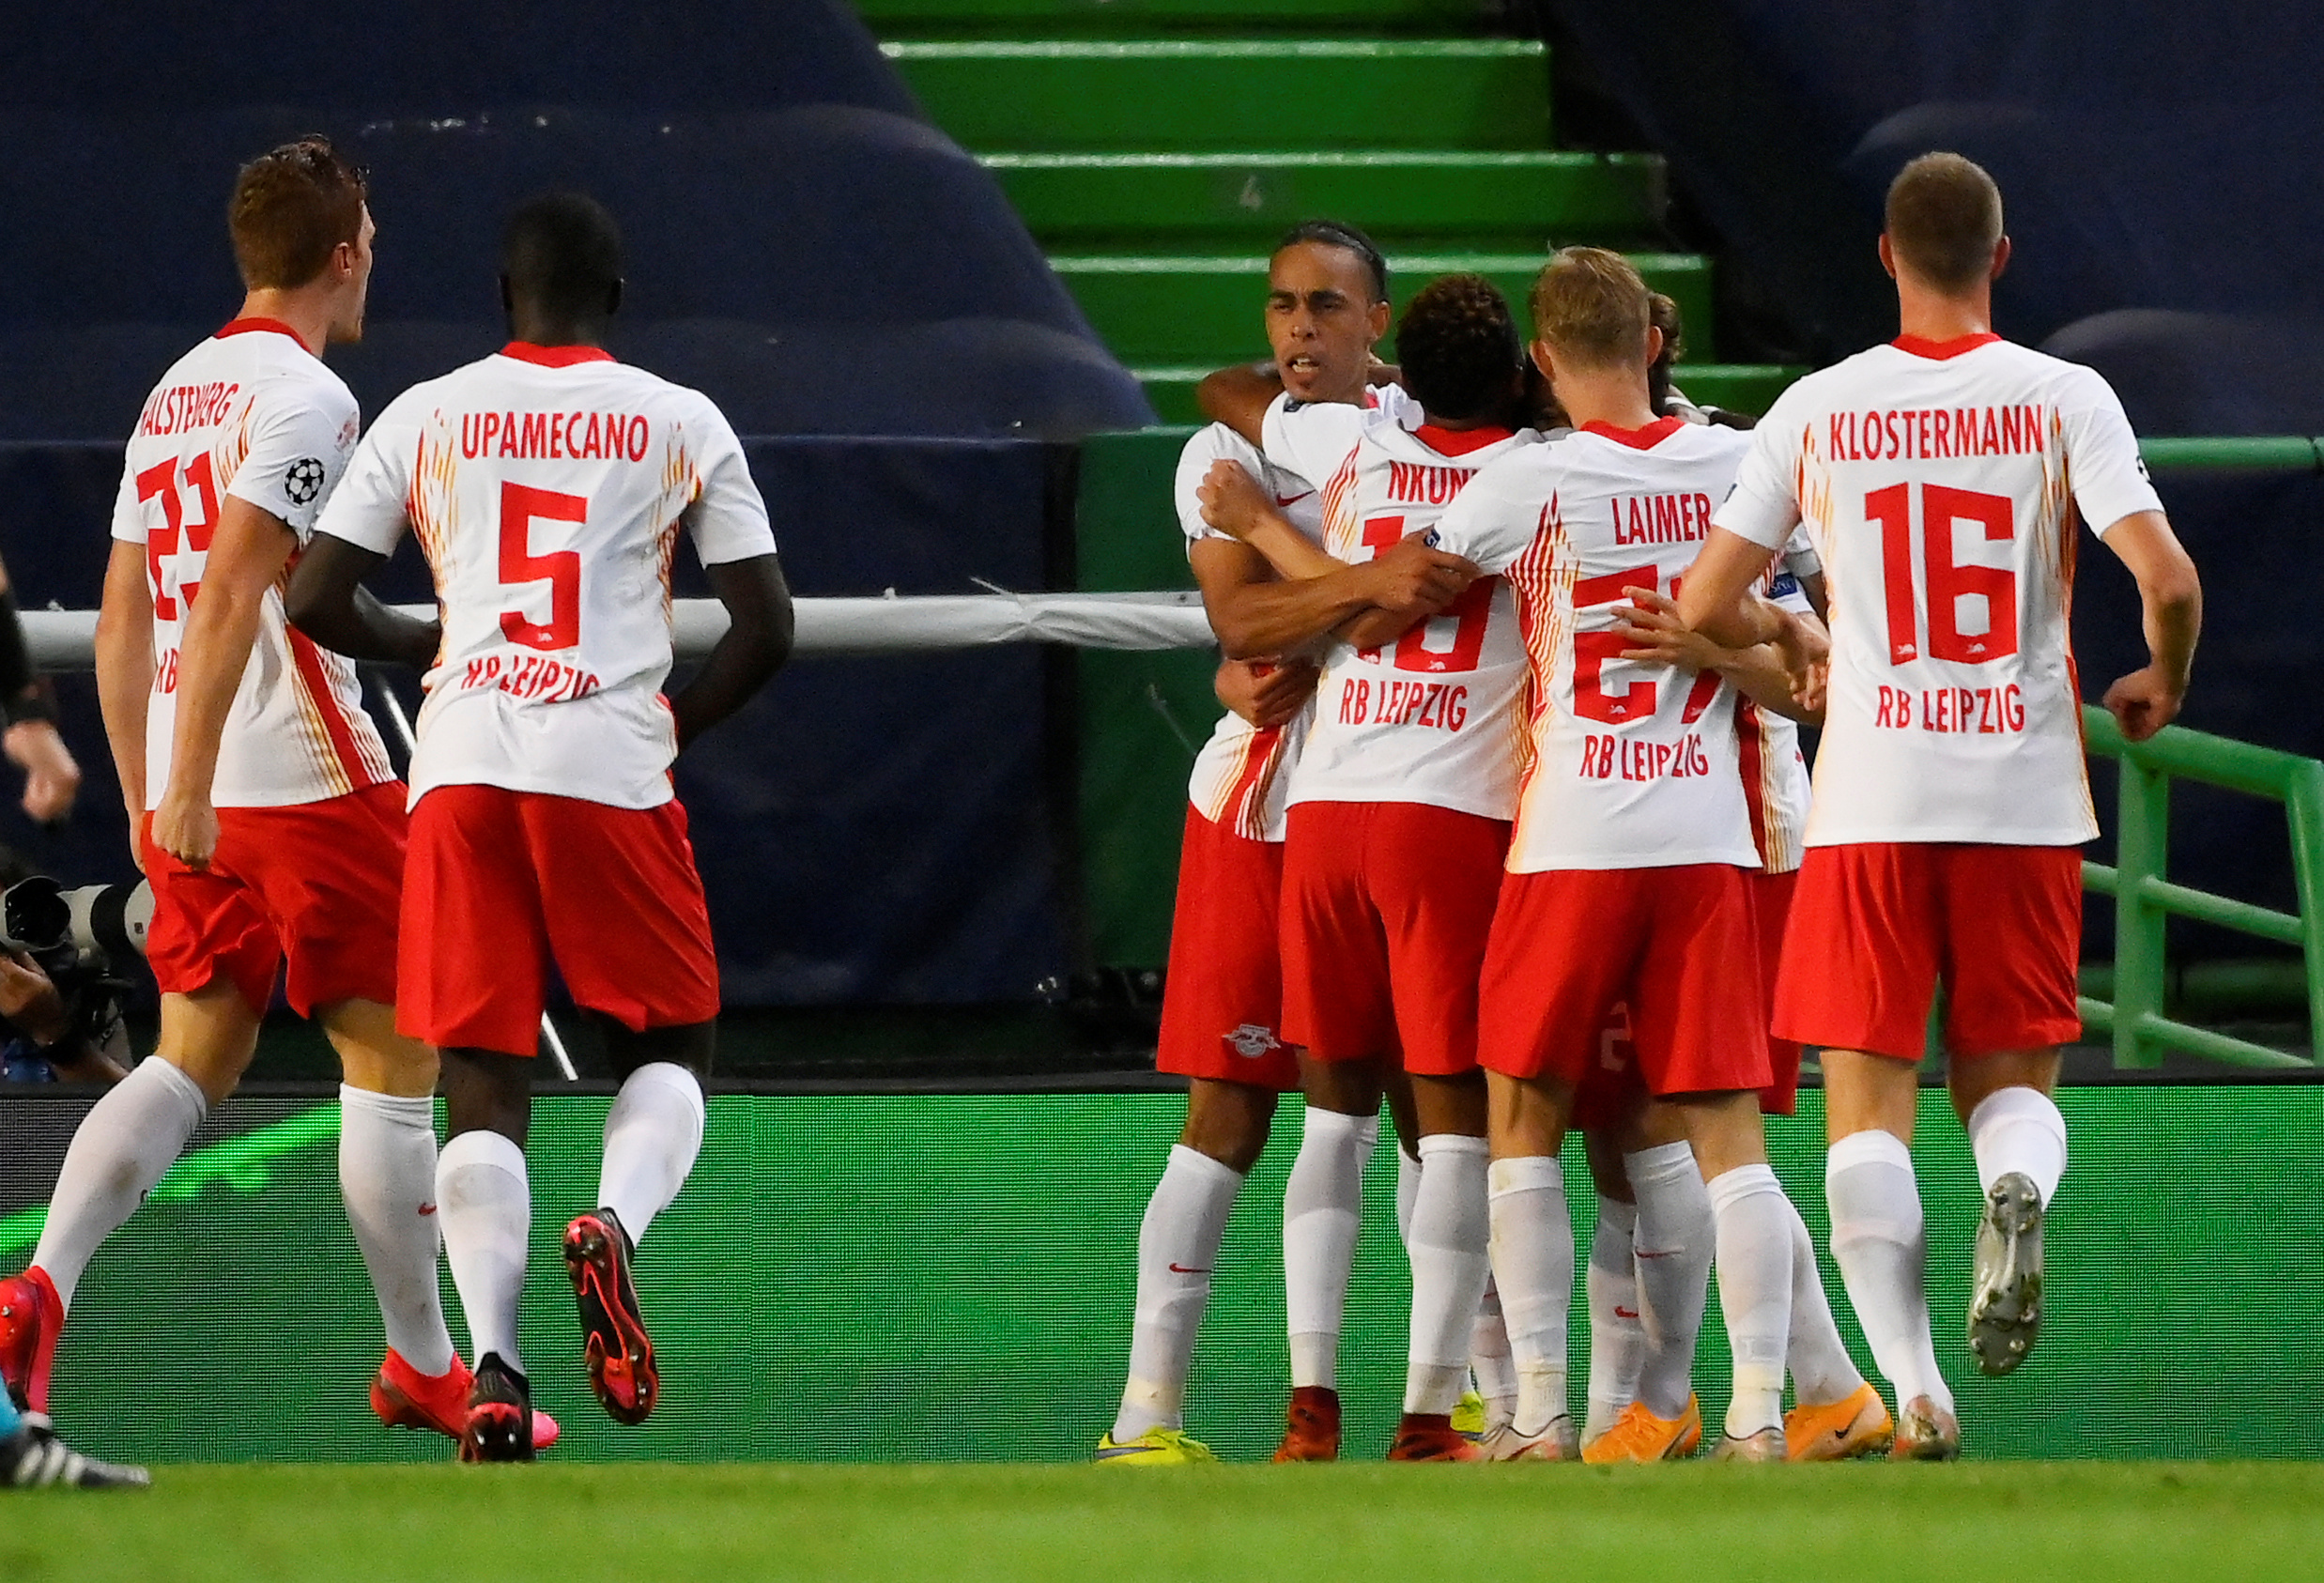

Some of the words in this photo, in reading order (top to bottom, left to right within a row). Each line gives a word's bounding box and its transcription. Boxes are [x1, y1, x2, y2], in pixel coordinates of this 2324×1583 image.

[462, 410, 649, 463] UPAMECANO
[1830, 404, 2044, 461] KLOSTERMANN
[1387, 458, 1482, 505] NKUN
[1610, 492, 1712, 546] LAIMER
[499, 480, 588, 652] 5
[1865, 481, 2019, 667] 16
[1338, 678, 1371, 726] RB
[1373, 680, 1468, 732] LEIPZIG
[1875, 684, 1912, 729] RB
[1922, 684, 2025, 734] LEIPZIG
[1579, 734, 1616, 779] RB
[1622, 732, 1709, 782] LEIPZIG
